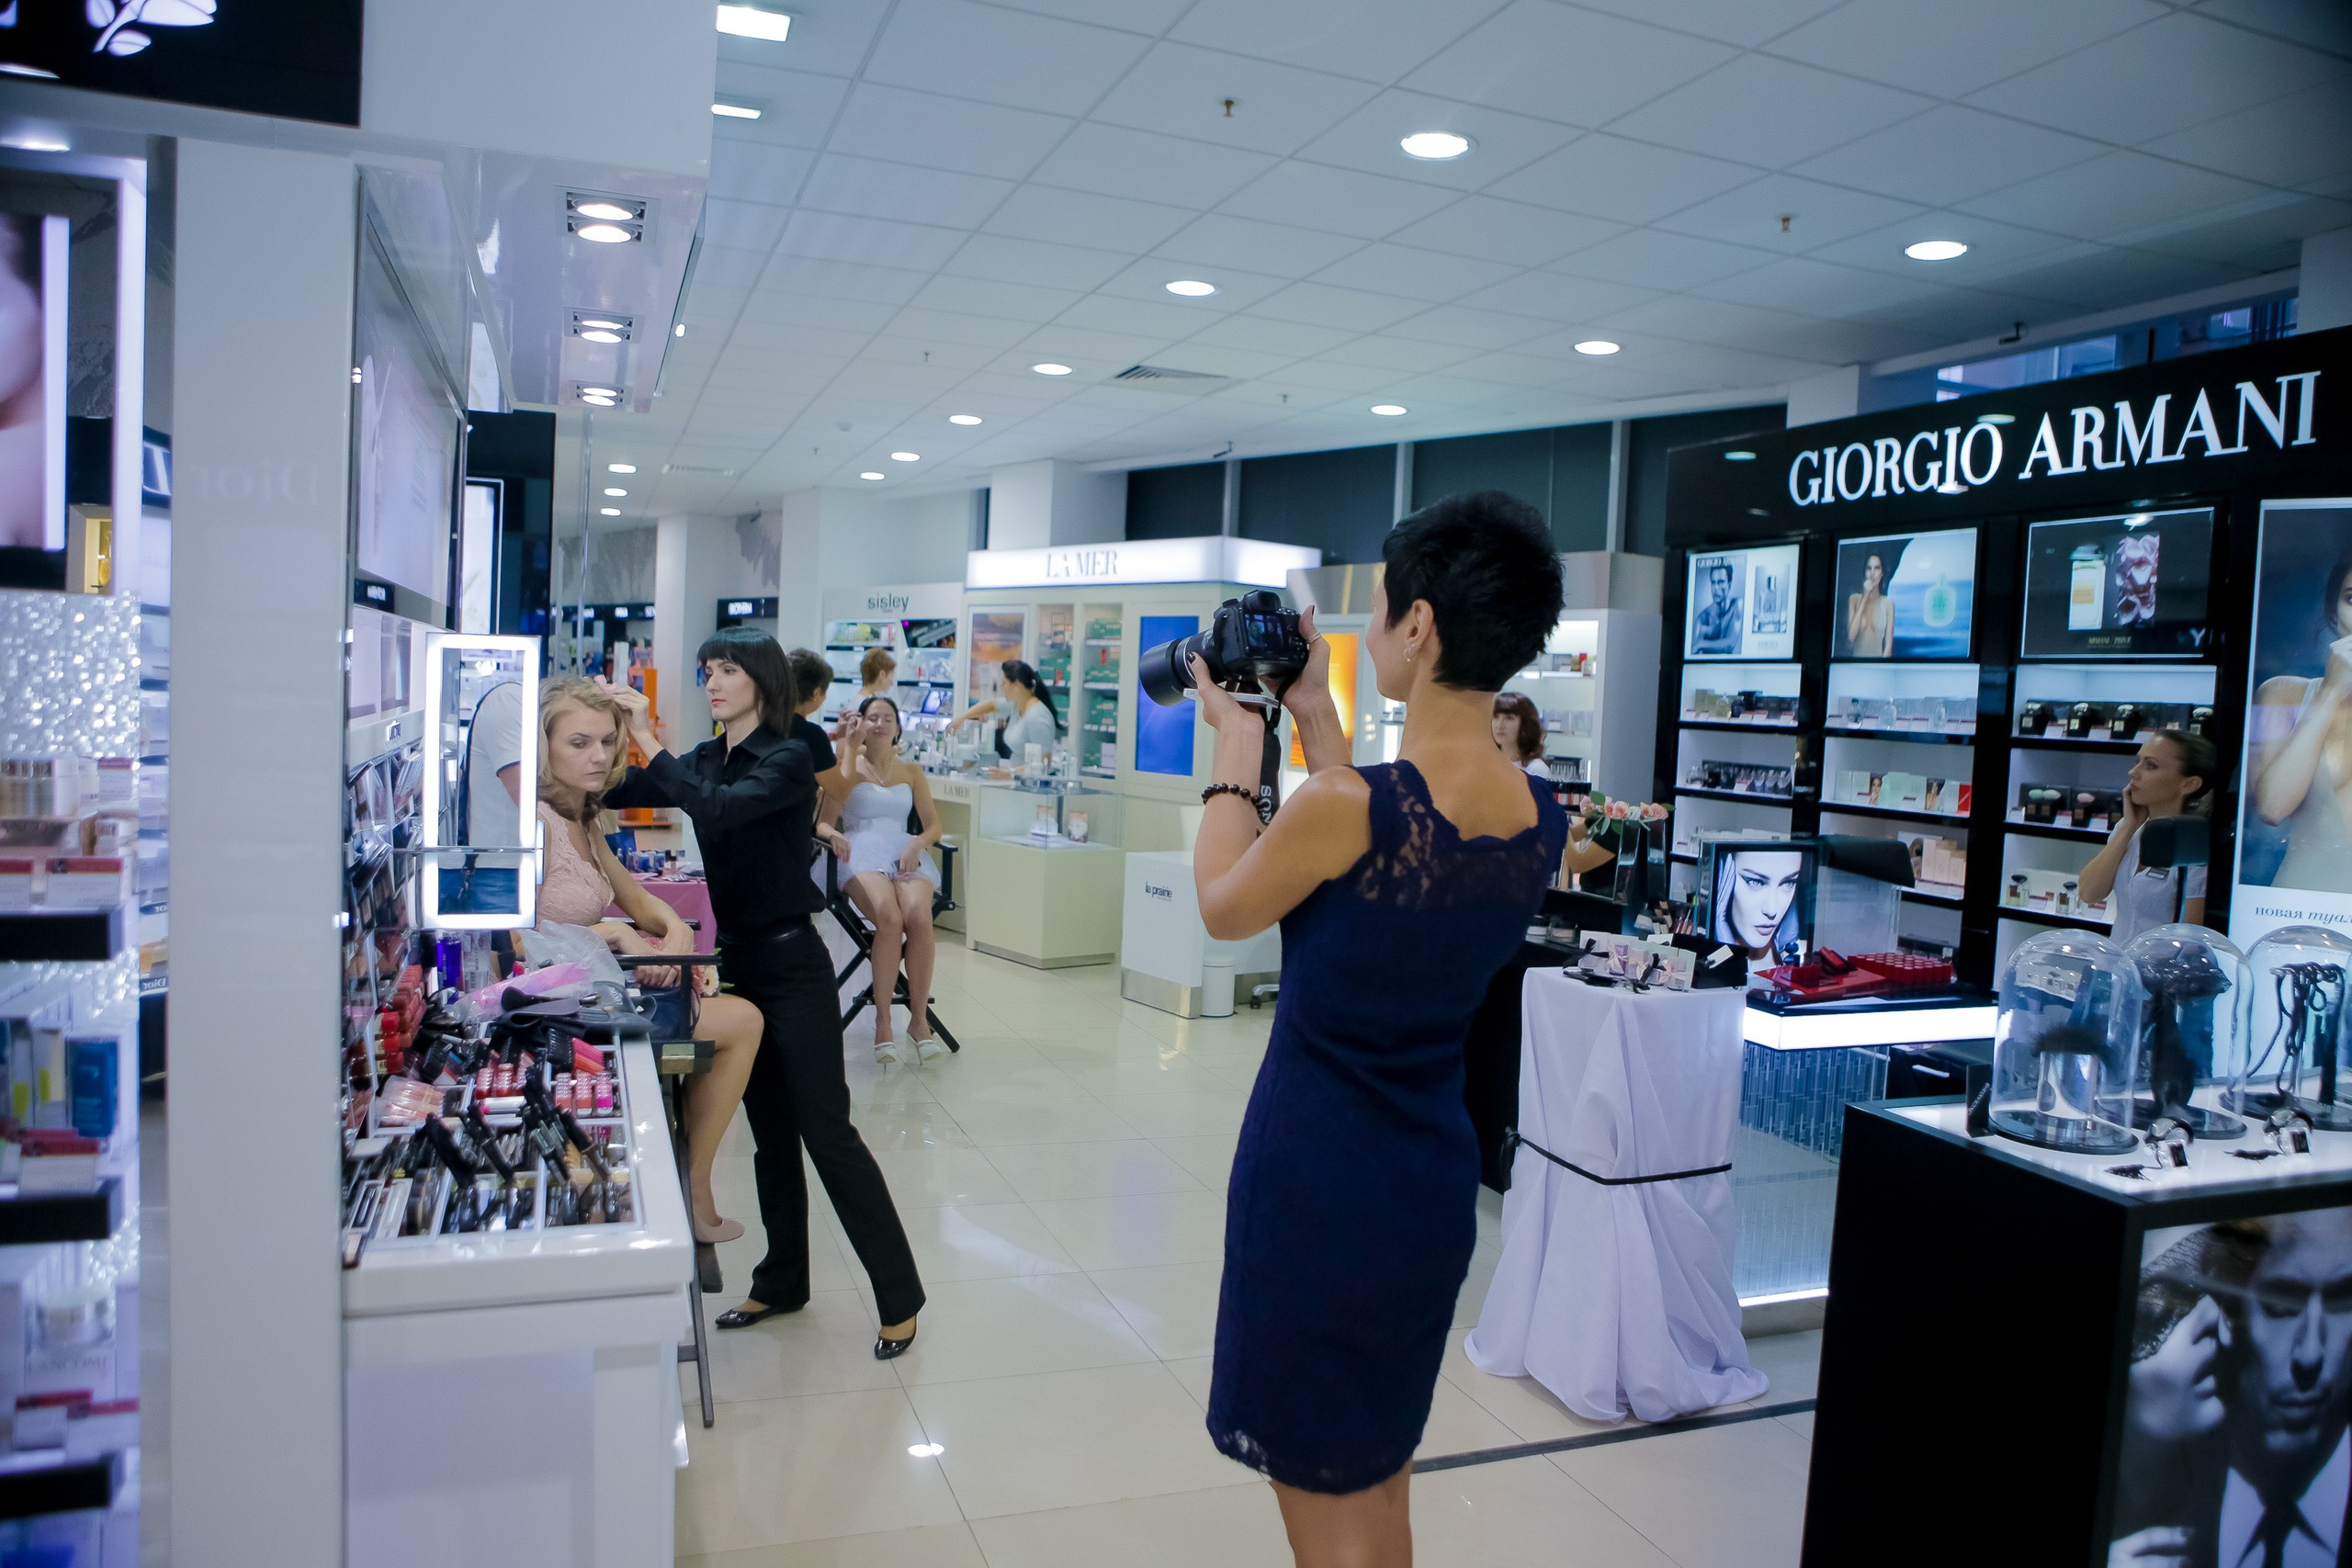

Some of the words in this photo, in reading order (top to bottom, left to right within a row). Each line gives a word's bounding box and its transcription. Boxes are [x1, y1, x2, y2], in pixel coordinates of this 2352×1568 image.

[1789, 422, 2003, 506] GIORGIO
[2018, 370, 2321, 479] ARMANI
[1046, 553, 1070, 578] LA
[1077, 550, 1117, 576] MER
[868, 593, 909, 613] sisley
[944, 784, 954, 795] LA
[955, 785, 971, 798] MER
[1260, 785, 1272, 824] SON
[2256, 907, 2303, 919] новая
